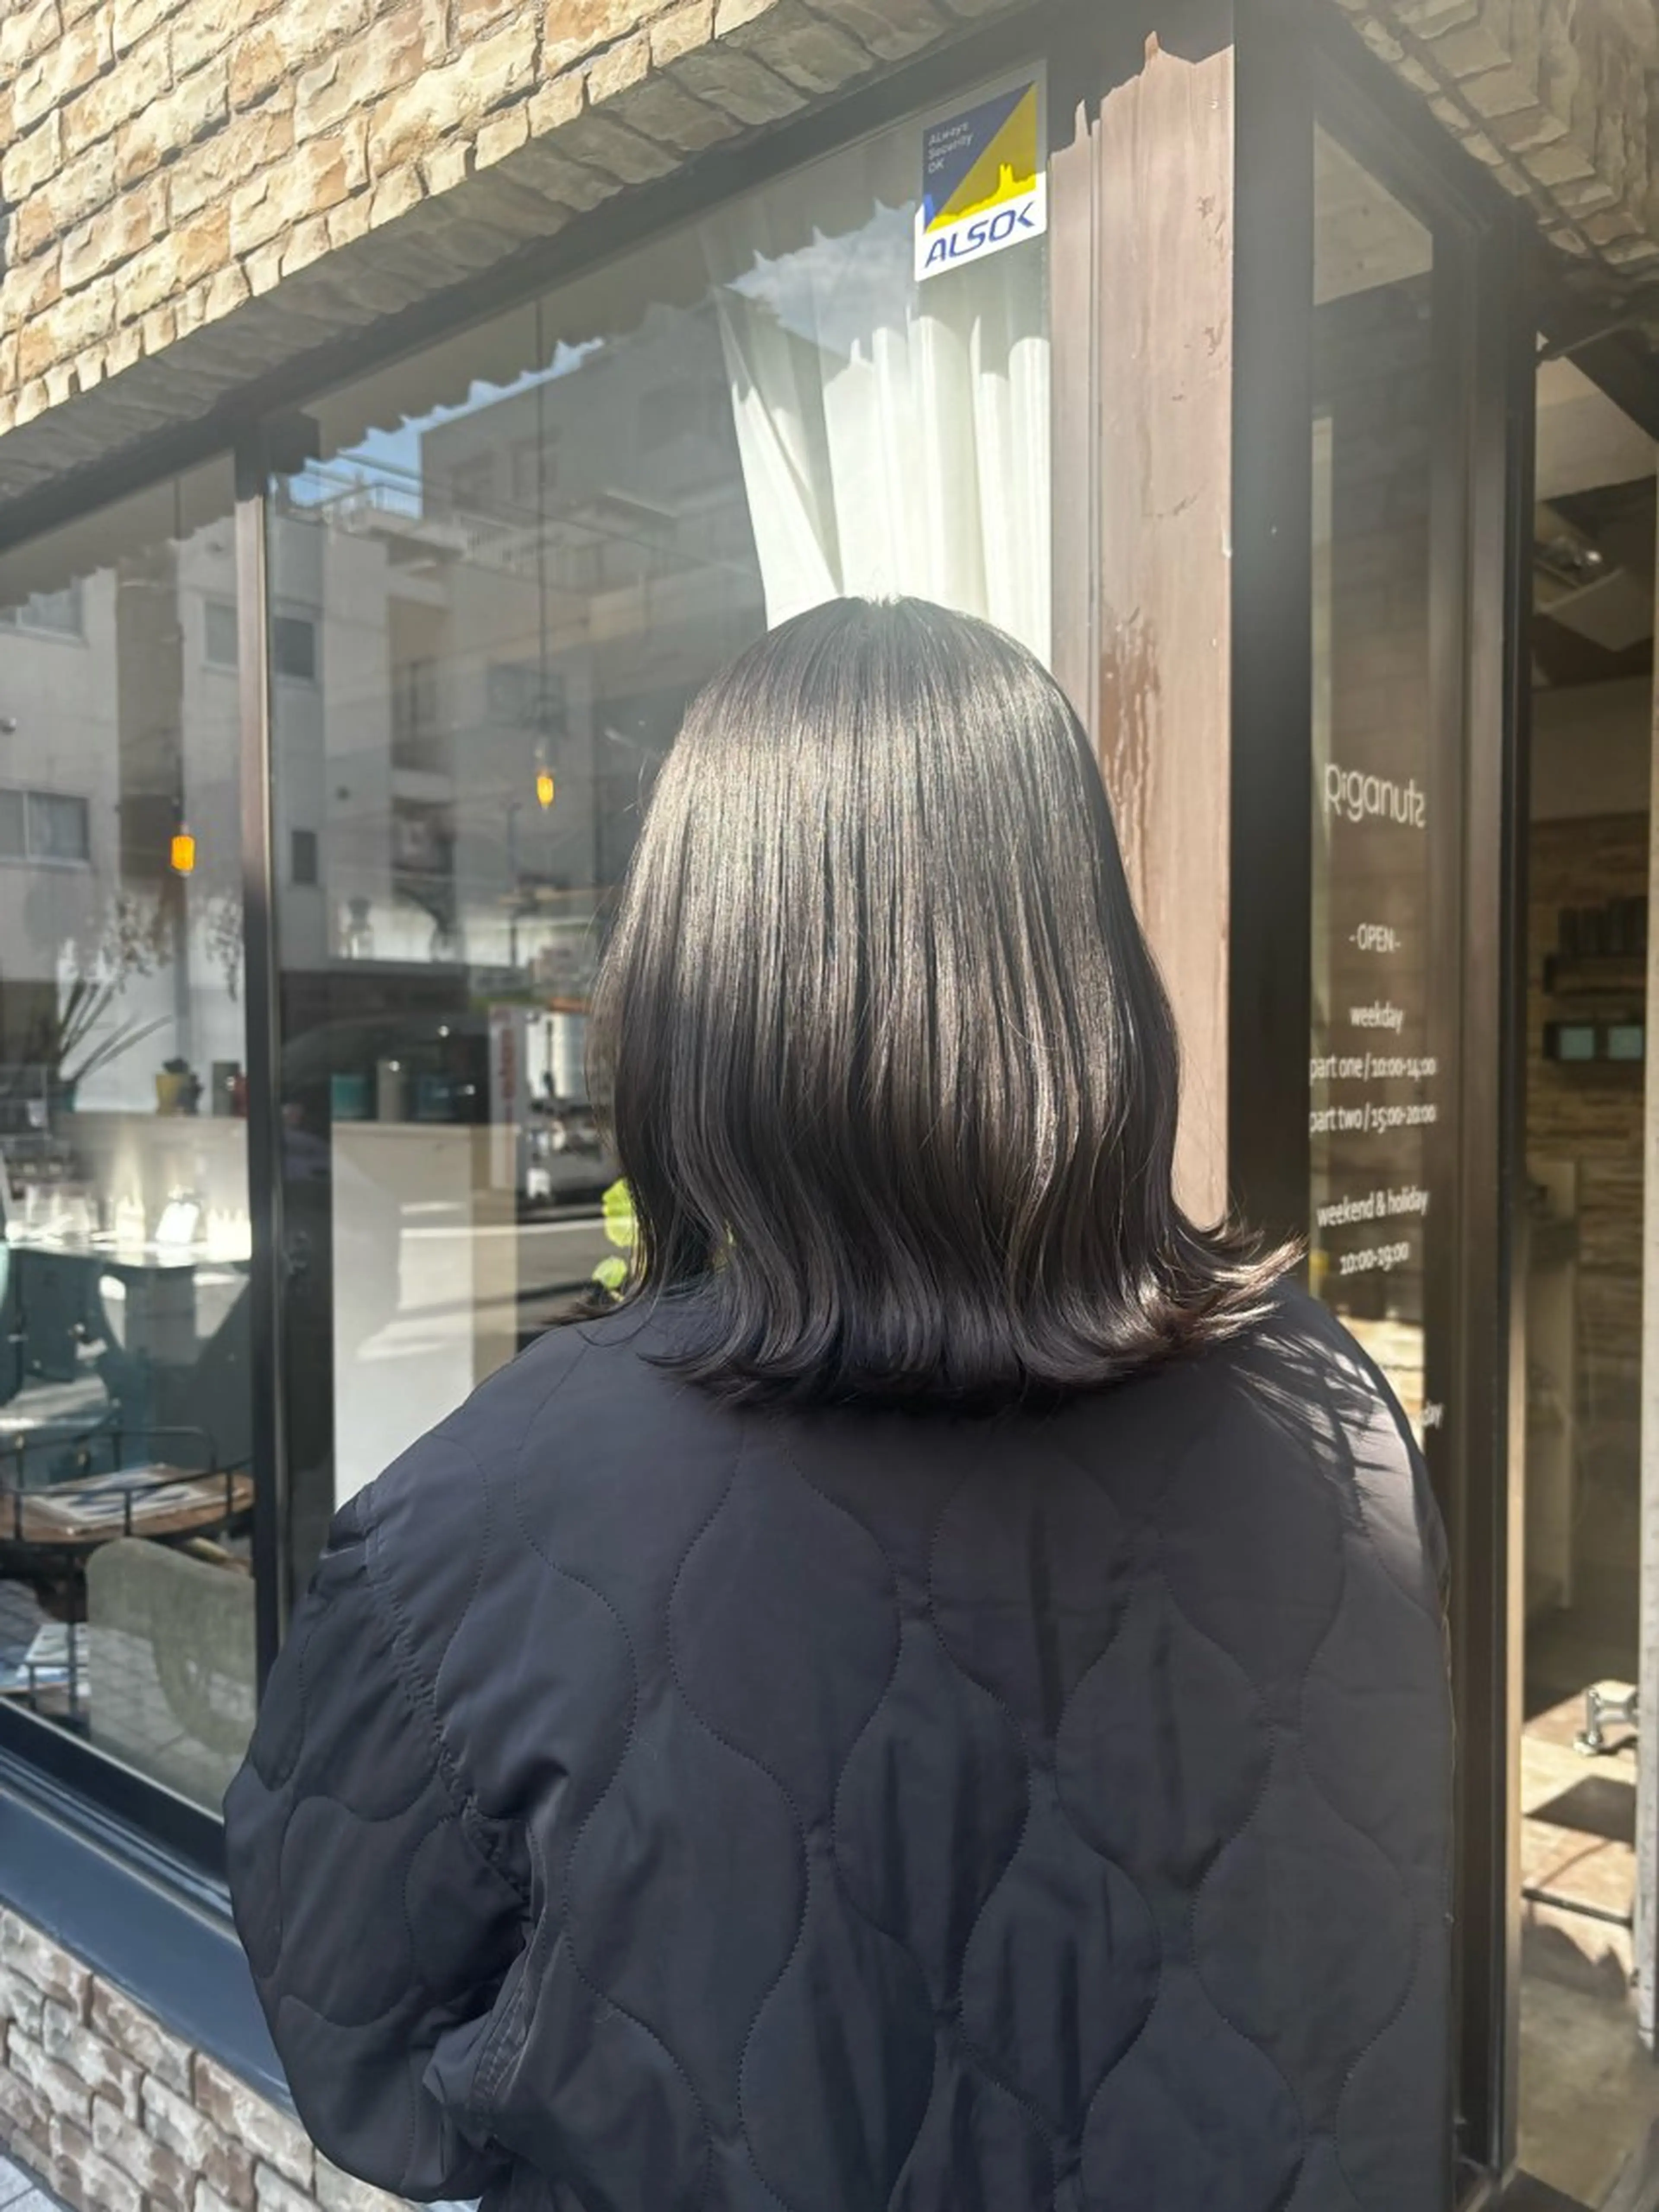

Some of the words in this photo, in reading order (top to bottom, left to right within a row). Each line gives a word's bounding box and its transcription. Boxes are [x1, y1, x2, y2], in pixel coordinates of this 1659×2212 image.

[925, 200, 1035, 268] ALSOK
[1349, 1000, 1403, 1034] weekday
[1309, 1054, 1337, 1086] part
[1339, 1058, 1363, 1079] one
[1309, 1107, 1336, 1138] part
[1338, 1106, 1363, 1131] two
[1317, 1190, 1374, 1228] weekend
[1376, 1191, 1386, 1217] &
[1387, 1184, 1430, 1216] holiday
